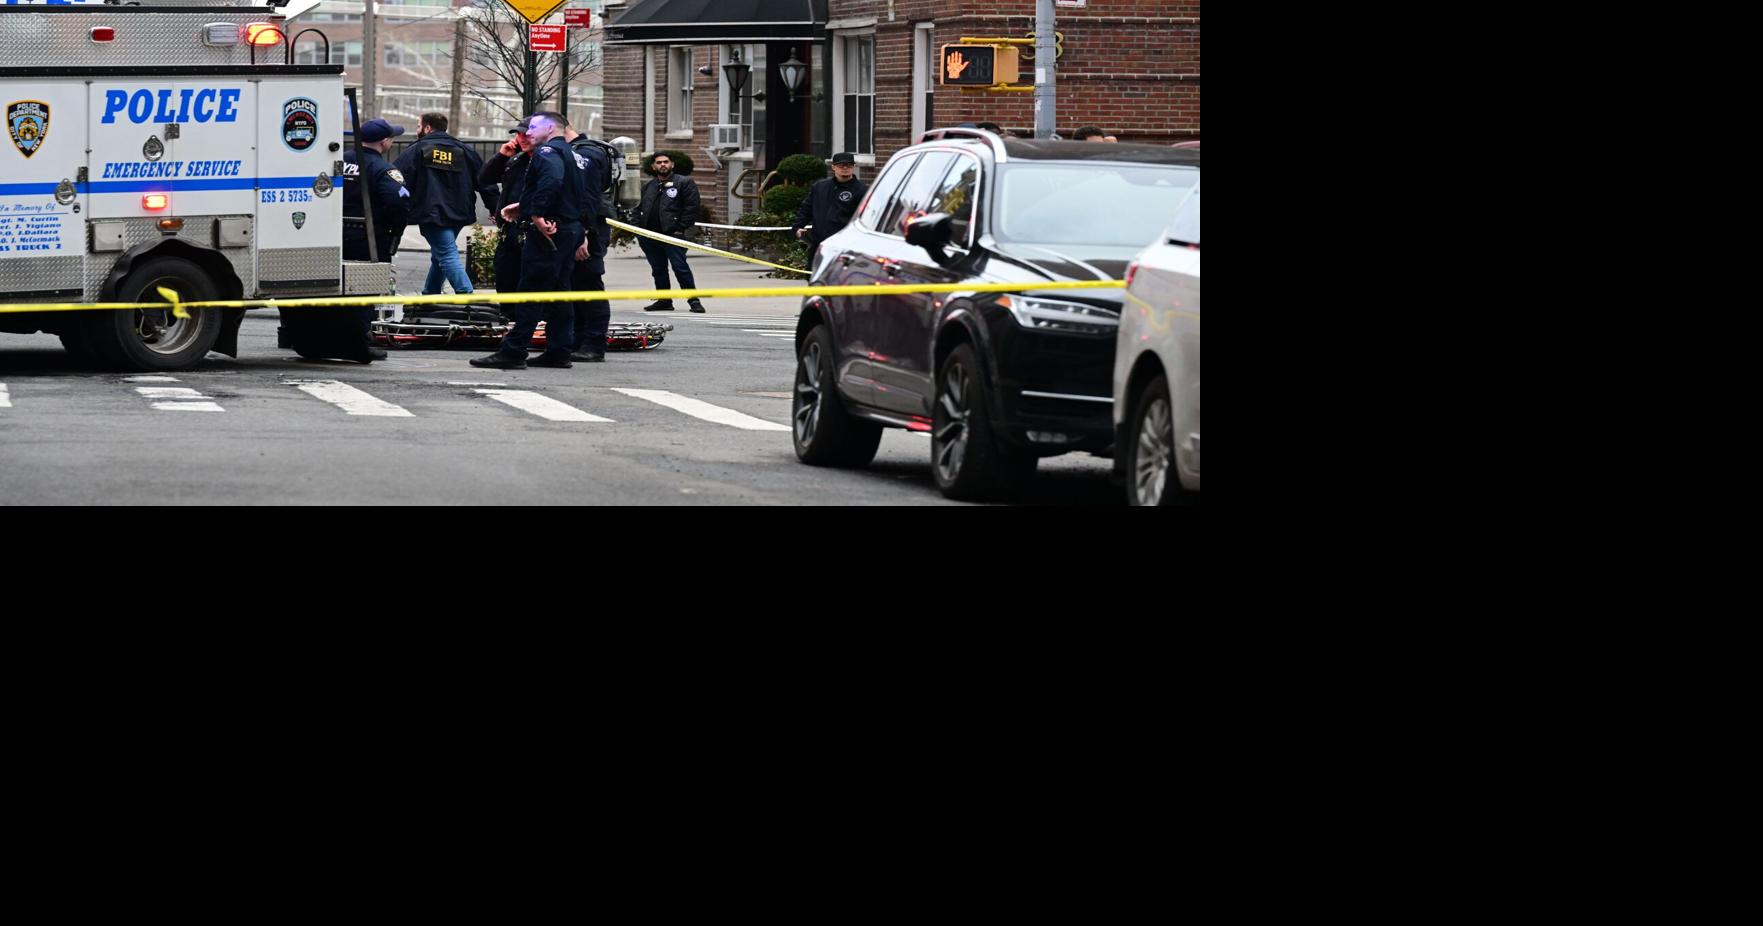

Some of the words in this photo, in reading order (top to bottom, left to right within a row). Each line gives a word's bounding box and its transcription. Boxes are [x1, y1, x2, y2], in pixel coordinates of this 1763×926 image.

[101, 88, 241, 124] POLICE
[285, 100, 317, 114] POLICE
[433, 149, 453, 162] FBI
[102, 161, 183, 178] EMERGENCY
[185, 160, 241, 177] SERVICE
[261, 190, 276, 203] ESS
[280, 190, 285, 202] 2
[288, 190, 308, 202] 5735
[14, 203, 42, 213] Memory
